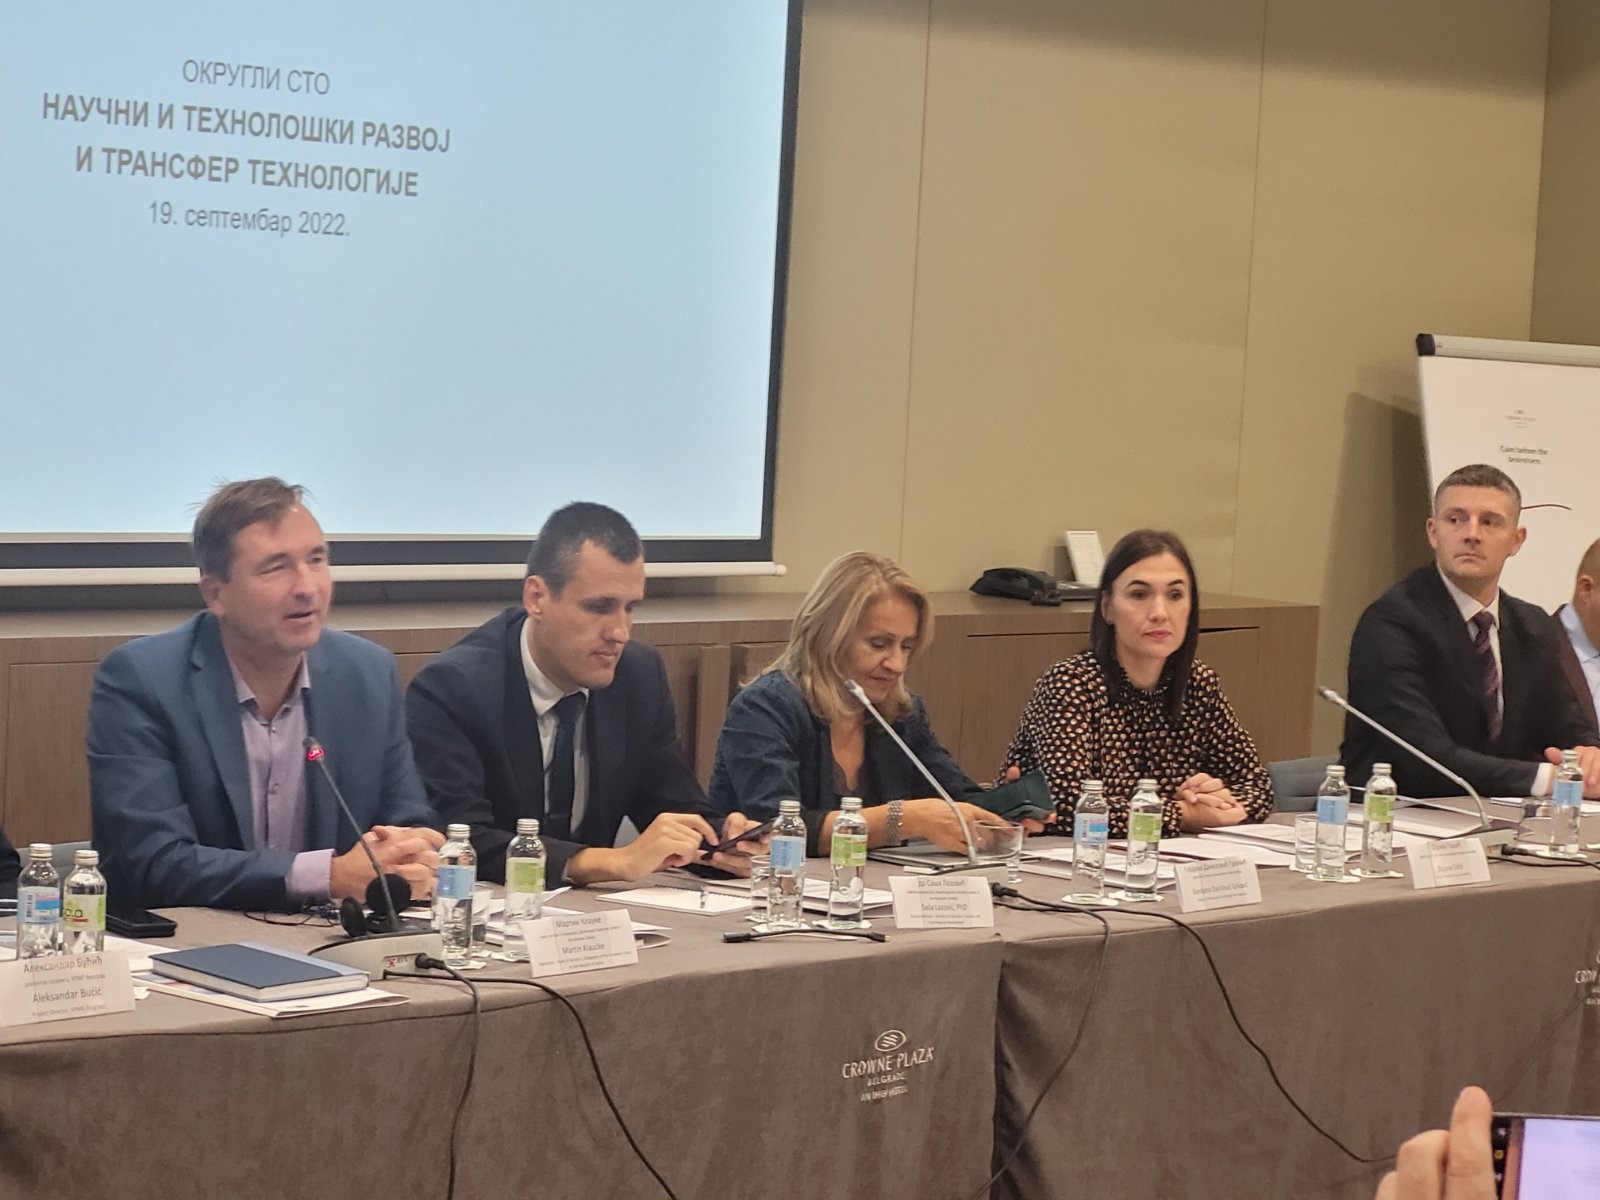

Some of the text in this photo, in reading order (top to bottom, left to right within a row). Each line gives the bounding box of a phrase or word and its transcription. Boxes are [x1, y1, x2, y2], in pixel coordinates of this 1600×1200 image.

[182, 59, 330, 95] ОКРУГЛИ СТО
[42, 92, 451, 154] НАУЧНИ И ТЕХНОЛОШКИ РАЗВОЈ
[75, 145, 419, 198] И ТРАНСФЕР ТЕХНОЛОГИЈЕ
[149, 201, 351, 238] 19. септембар 2022.
[24, 959, 75, 974] Александар
[32, 989, 78, 1004] Aleksandar
[842, 1047, 934, 1079] CROWNE PLAZA
